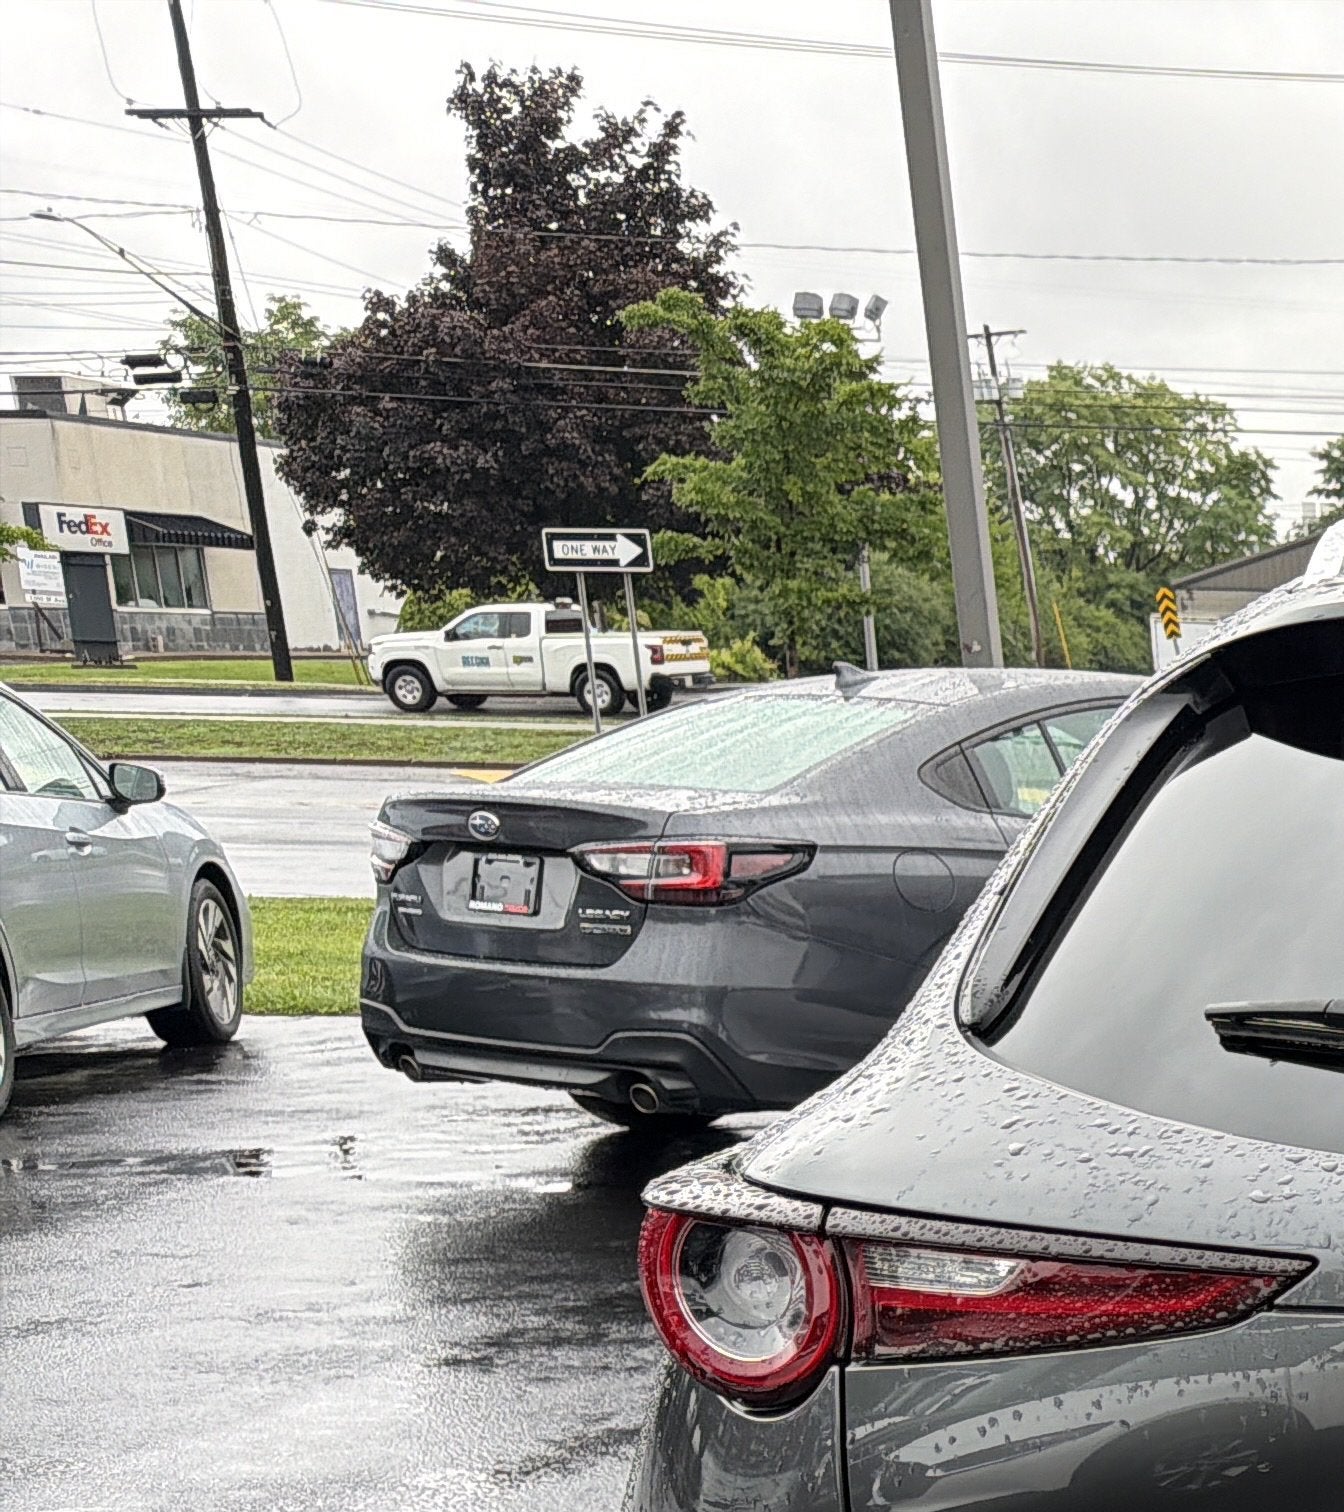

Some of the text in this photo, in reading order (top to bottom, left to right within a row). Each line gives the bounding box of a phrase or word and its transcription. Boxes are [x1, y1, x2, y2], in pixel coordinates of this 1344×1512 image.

[56, 511, 112, 536] FedEx
[90, 537, 113, 548] Office
[561, 543, 617, 557] ONE WAY
